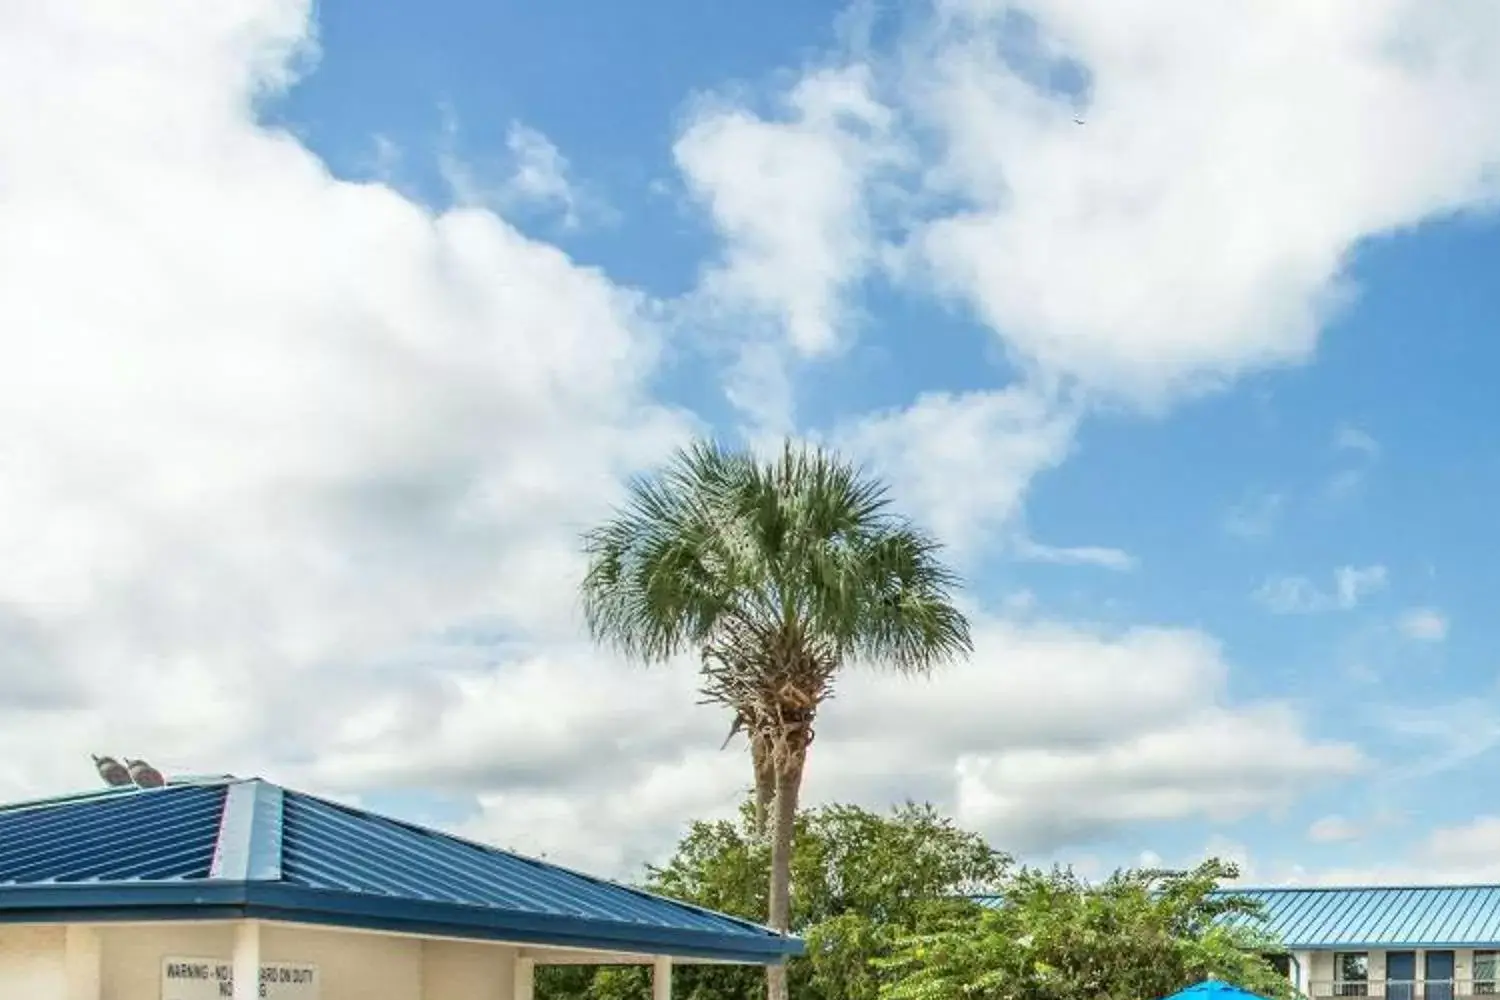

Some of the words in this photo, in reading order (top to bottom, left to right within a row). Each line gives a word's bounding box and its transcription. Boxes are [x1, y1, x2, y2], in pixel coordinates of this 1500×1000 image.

[167, 963, 209, 980] WARNING
[216, 966, 228, 981] NO
[292, 969, 314, 984] DUTY
